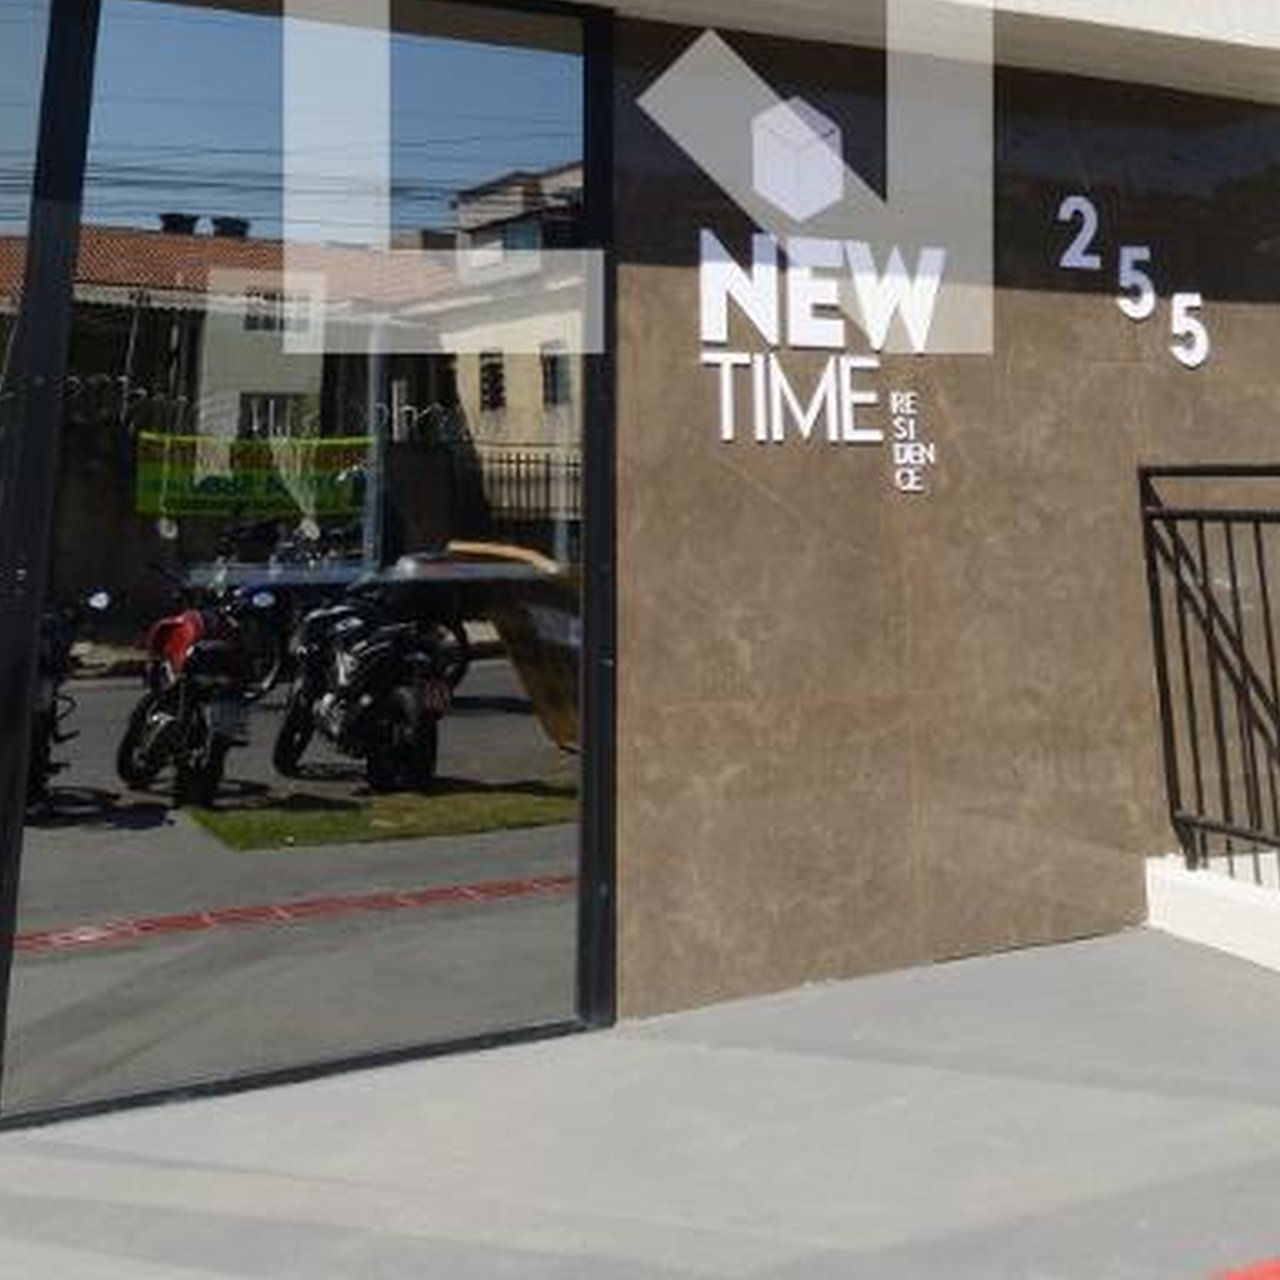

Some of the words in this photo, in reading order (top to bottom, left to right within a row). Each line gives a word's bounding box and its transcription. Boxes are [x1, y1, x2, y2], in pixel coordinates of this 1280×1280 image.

[700, 228, 945, 352] NEW
[1057, 195, 1209, 369] 255
[700, 351, 884, 443] TIME
